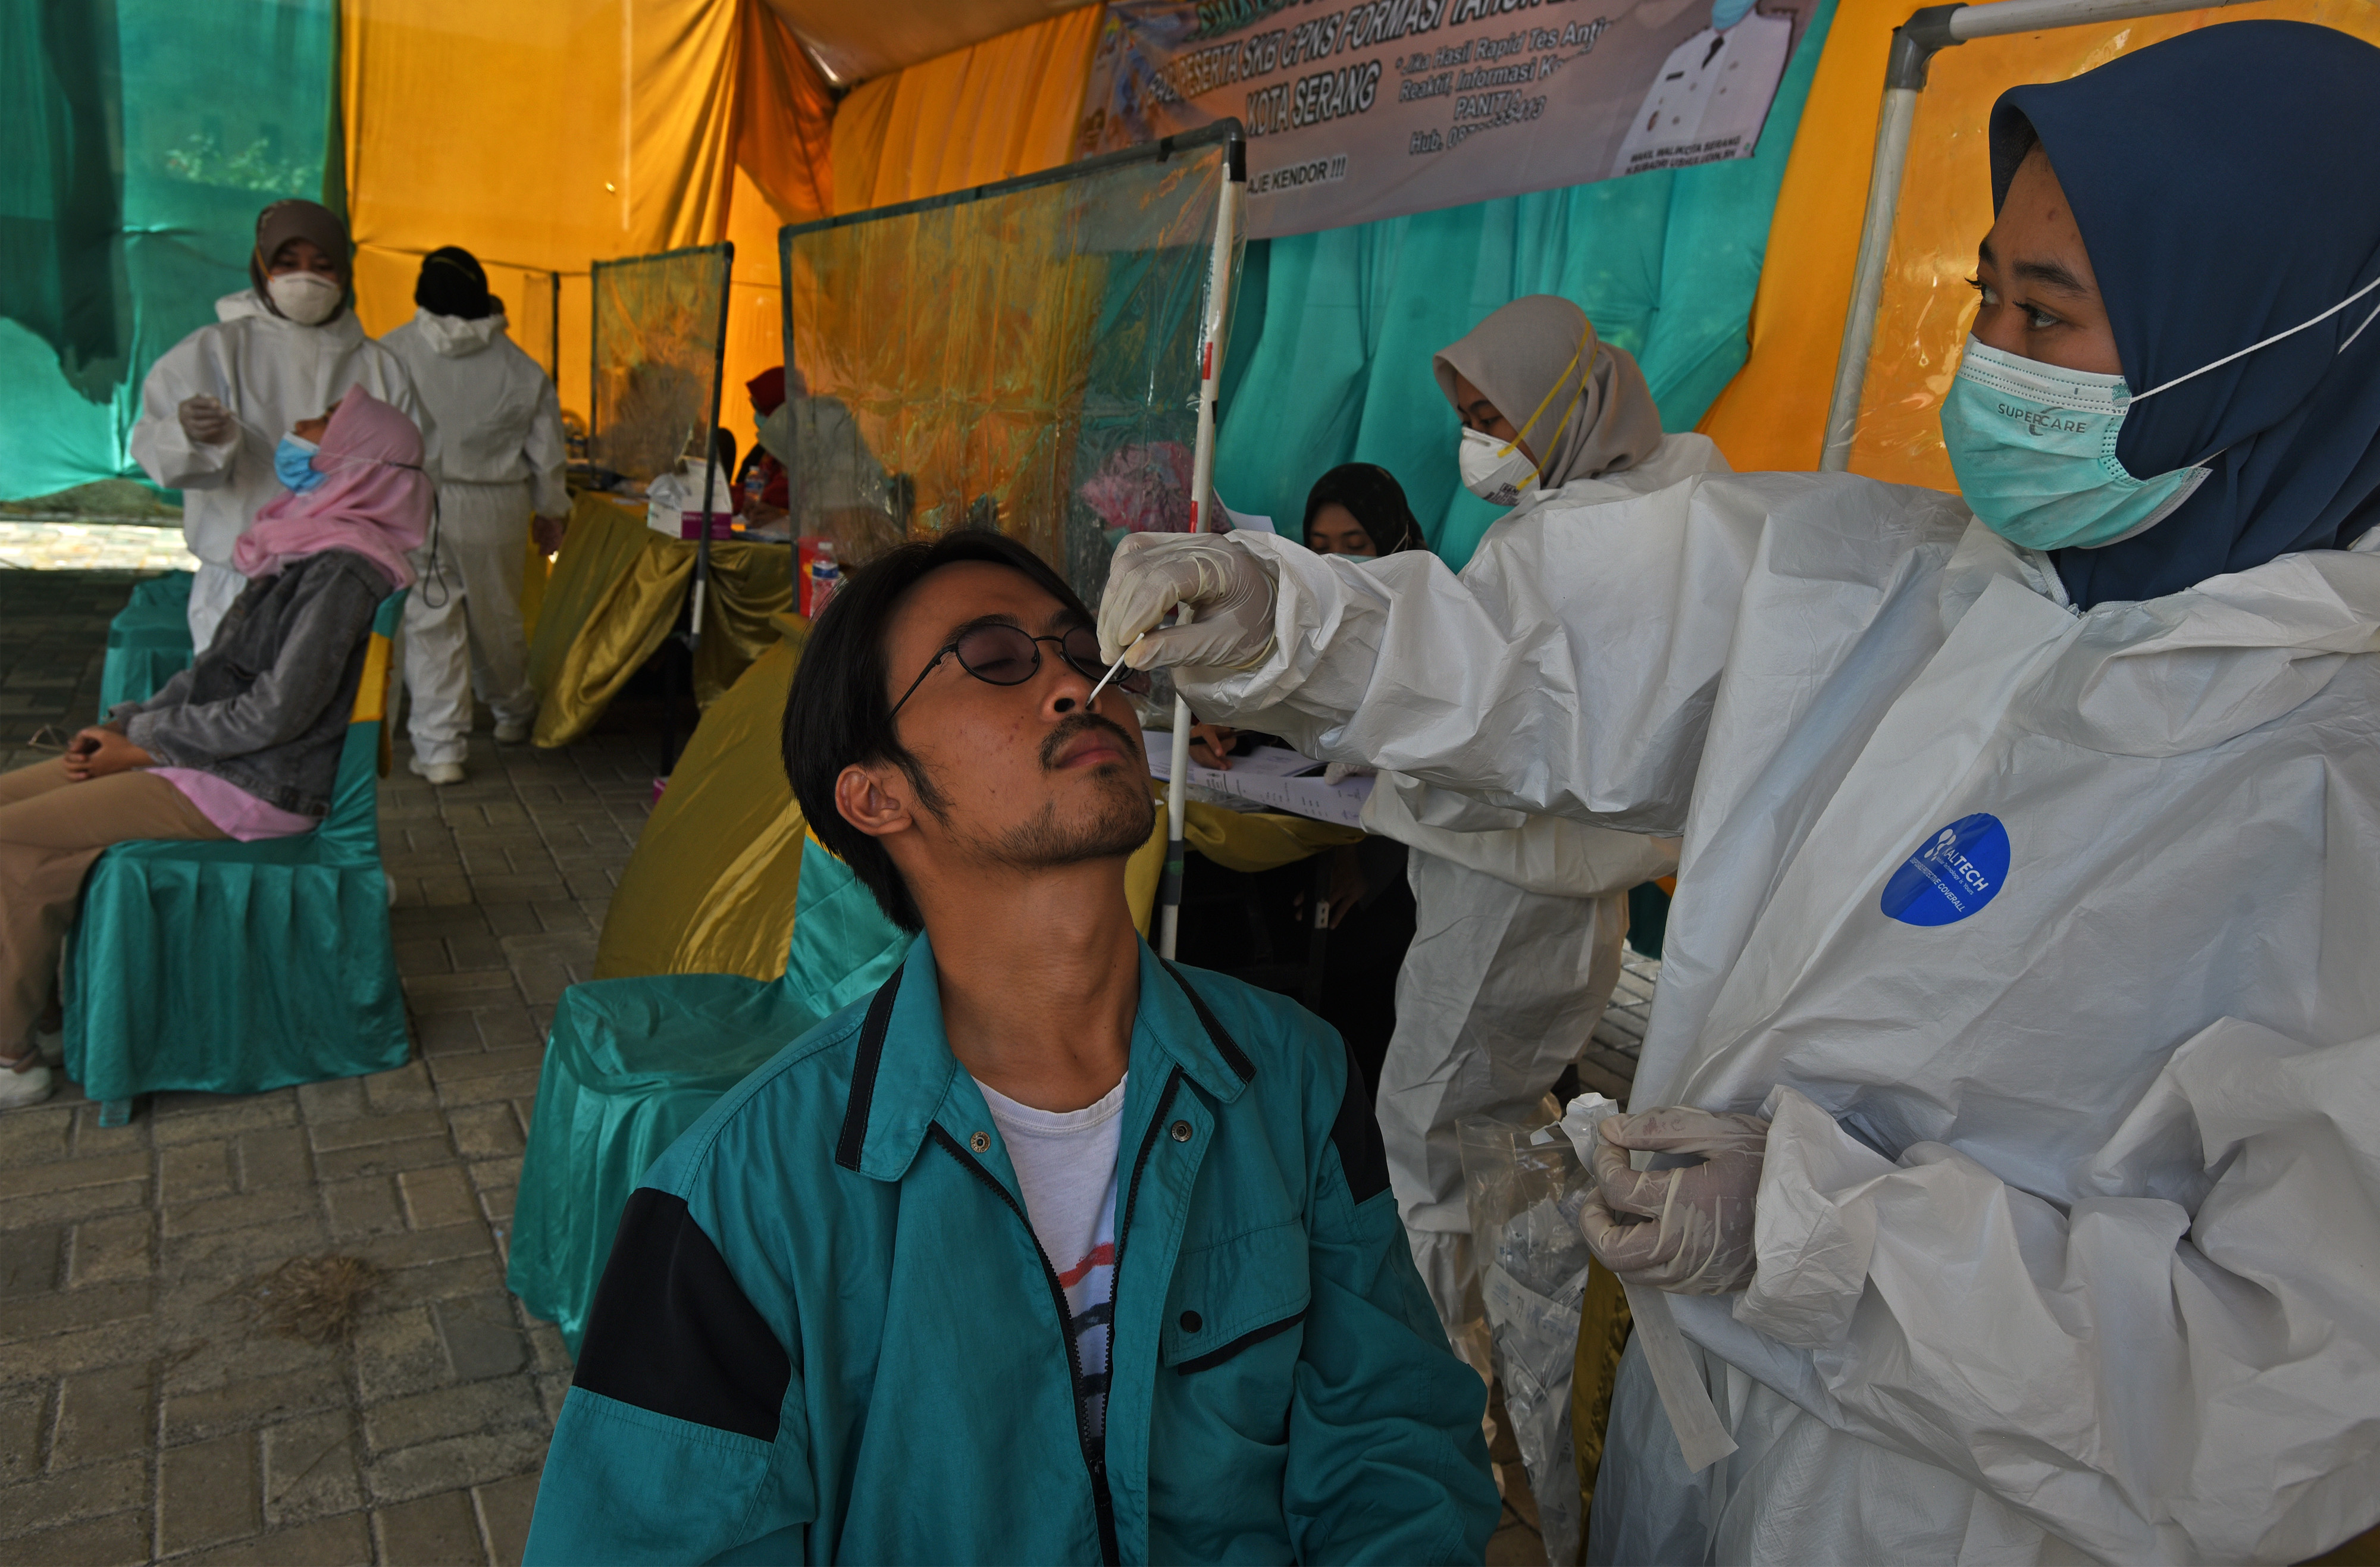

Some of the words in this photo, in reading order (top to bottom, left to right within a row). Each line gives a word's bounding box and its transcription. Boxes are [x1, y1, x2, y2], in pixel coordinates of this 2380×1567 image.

[1241, 29, 1286, 81] SKB
[1280, 11, 1344, 69] CPNS
[1335, 0, 1448, 54] FORMASI
[1432, 40, 1474, 69] Hasil
[1474, 31, 1527, 63] Rapid
[1527, 27, 1560, 52] Tes
[1456, 57, 1538, 92] Informasi
[1245, 81, 1290, 137] KOTA
[1292, 58, 1382, 129] SERANG
[1409, 129, 1444, 155] Hub.
[1271, 161, 1329, 189] KENDOR
[1997, 403, 2087, 434] SUPERCARE
[1941, 846, 1989, 892] KALTECH
[1937, 883, 1965, 913] COVERALL
[1963, 882, 1974, 895] Yours
